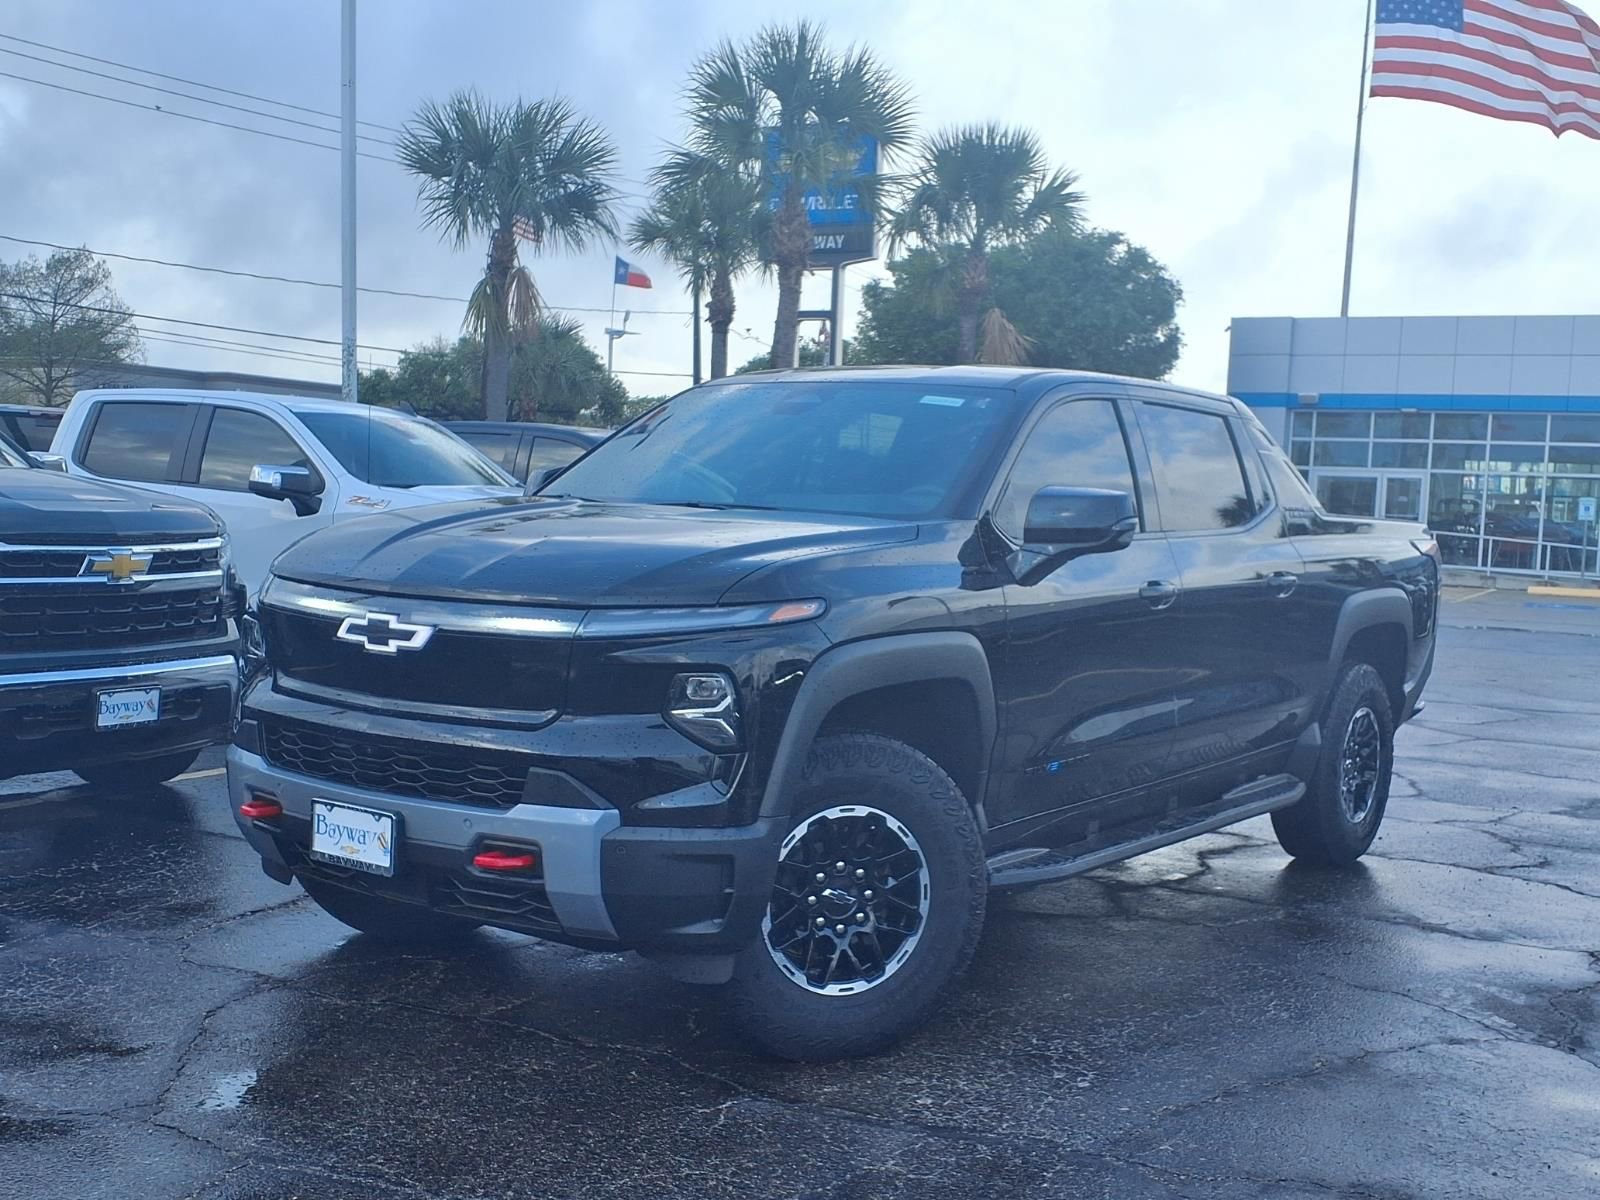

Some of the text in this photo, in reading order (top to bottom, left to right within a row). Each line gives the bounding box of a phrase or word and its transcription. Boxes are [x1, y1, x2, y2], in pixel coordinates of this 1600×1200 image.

[813, 234, 845, 249] WAY
[100, 700, 146, 719] Bayway
[315, 813, 377, 846] Bayway
